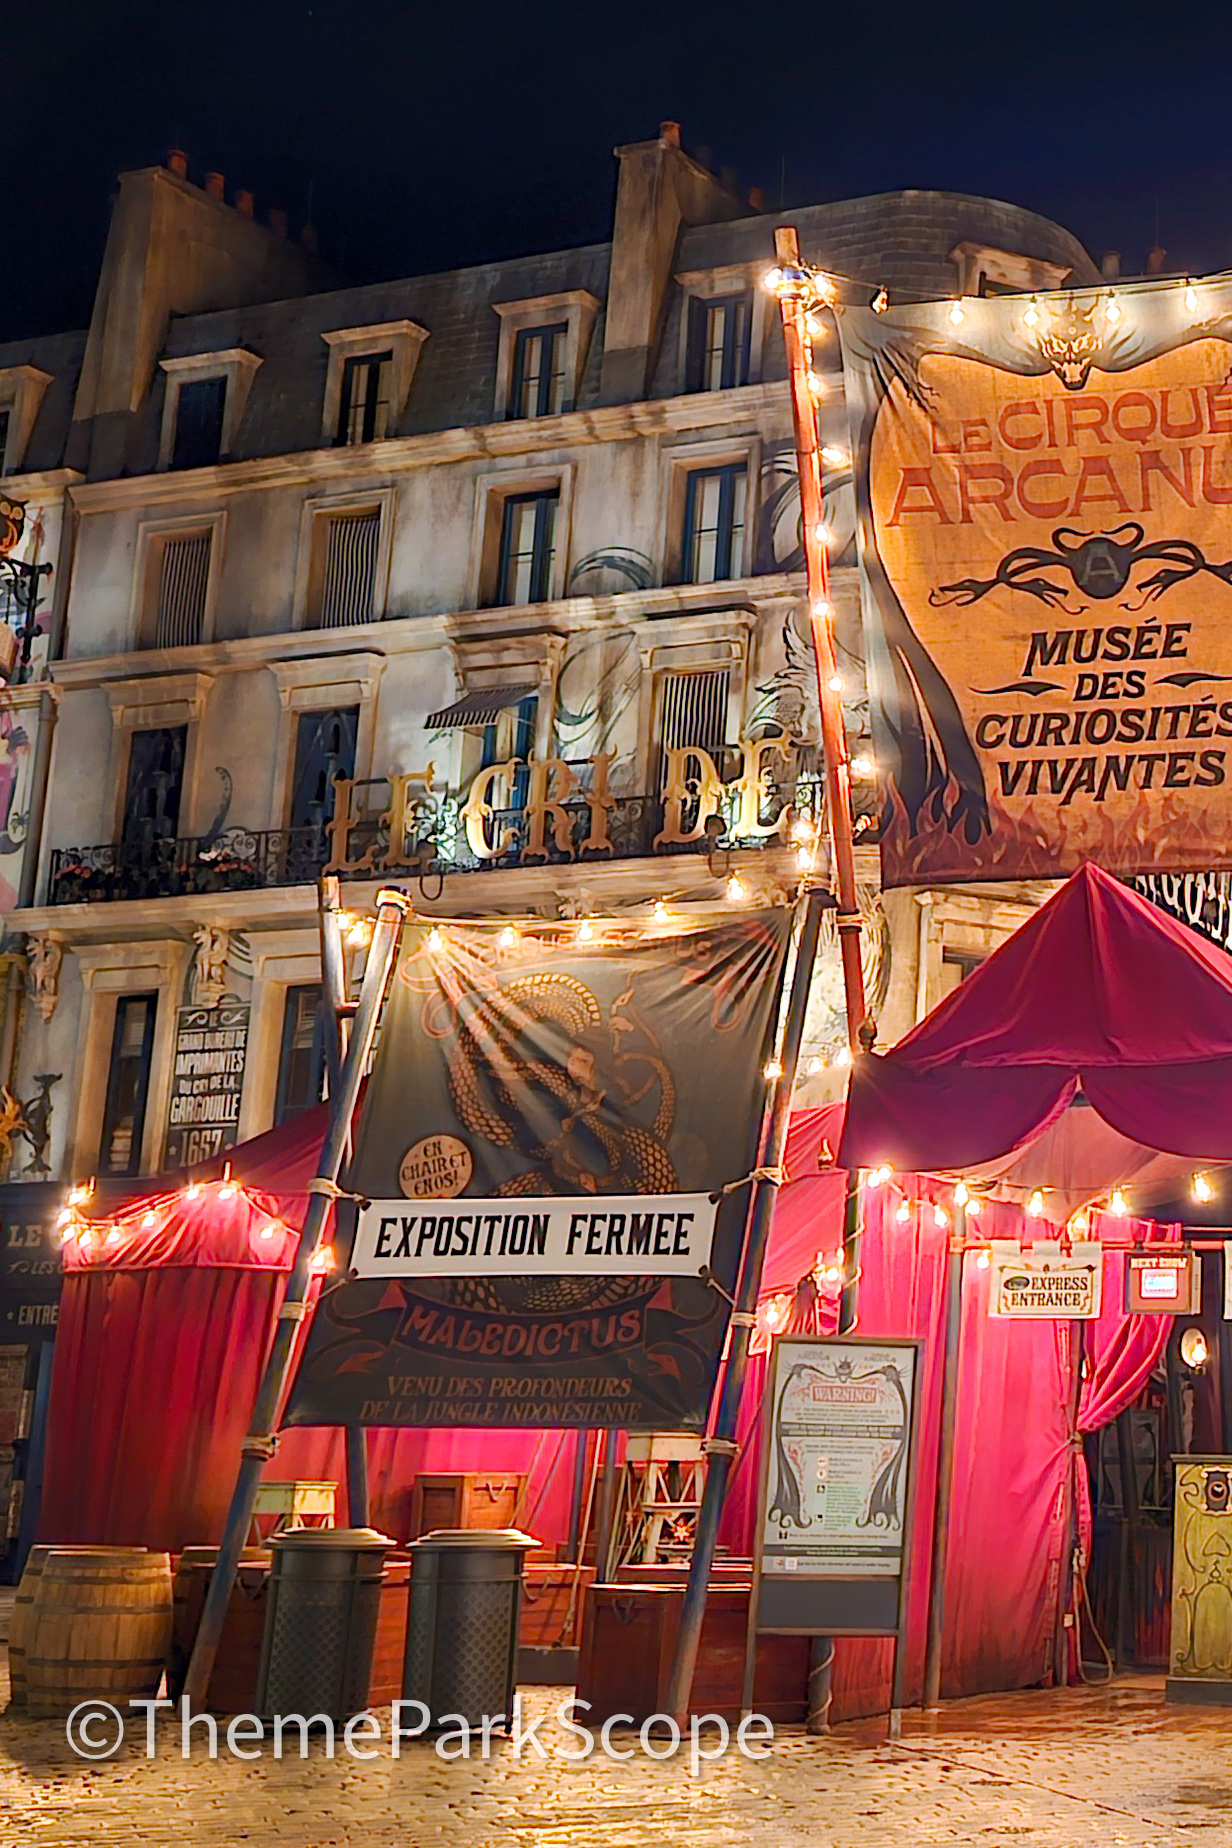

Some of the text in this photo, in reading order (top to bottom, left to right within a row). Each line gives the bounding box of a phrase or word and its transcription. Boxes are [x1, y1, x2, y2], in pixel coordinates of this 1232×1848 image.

[931, 417, 996, 455] LE
[1022, 615, 1192, 678] MUSÉE
[1073, 669, 1147, 702] DES
[997, 751, 1226, 805] VIVANTES
[321, 726, 796, 874] LE CRI DE
[169, 1093, 241, 1124] GARGOUILLE
[7, 1224, 43, 1248] LE
[373, 1212, 695, 1259] EXPOSITION FERMEE
[1031, 1276, 1088, 1291] EXPRESS
[18, 1301, 60, 1326] ENTRÉ
[1011, 1292, 1081, 1307] ENTRANCE
[401, 1305, 643, 1358] MALEDICTUS
[386, 1375, 633, 1398] VENU DES PROFONDEURS
[814, 1387, 875, 1402] WARNING!
[358, 1400, 388, 1421] DE
[391, 1401, 418, 1421] LA
[419, 1401, 498, 1424] JUNGLE
